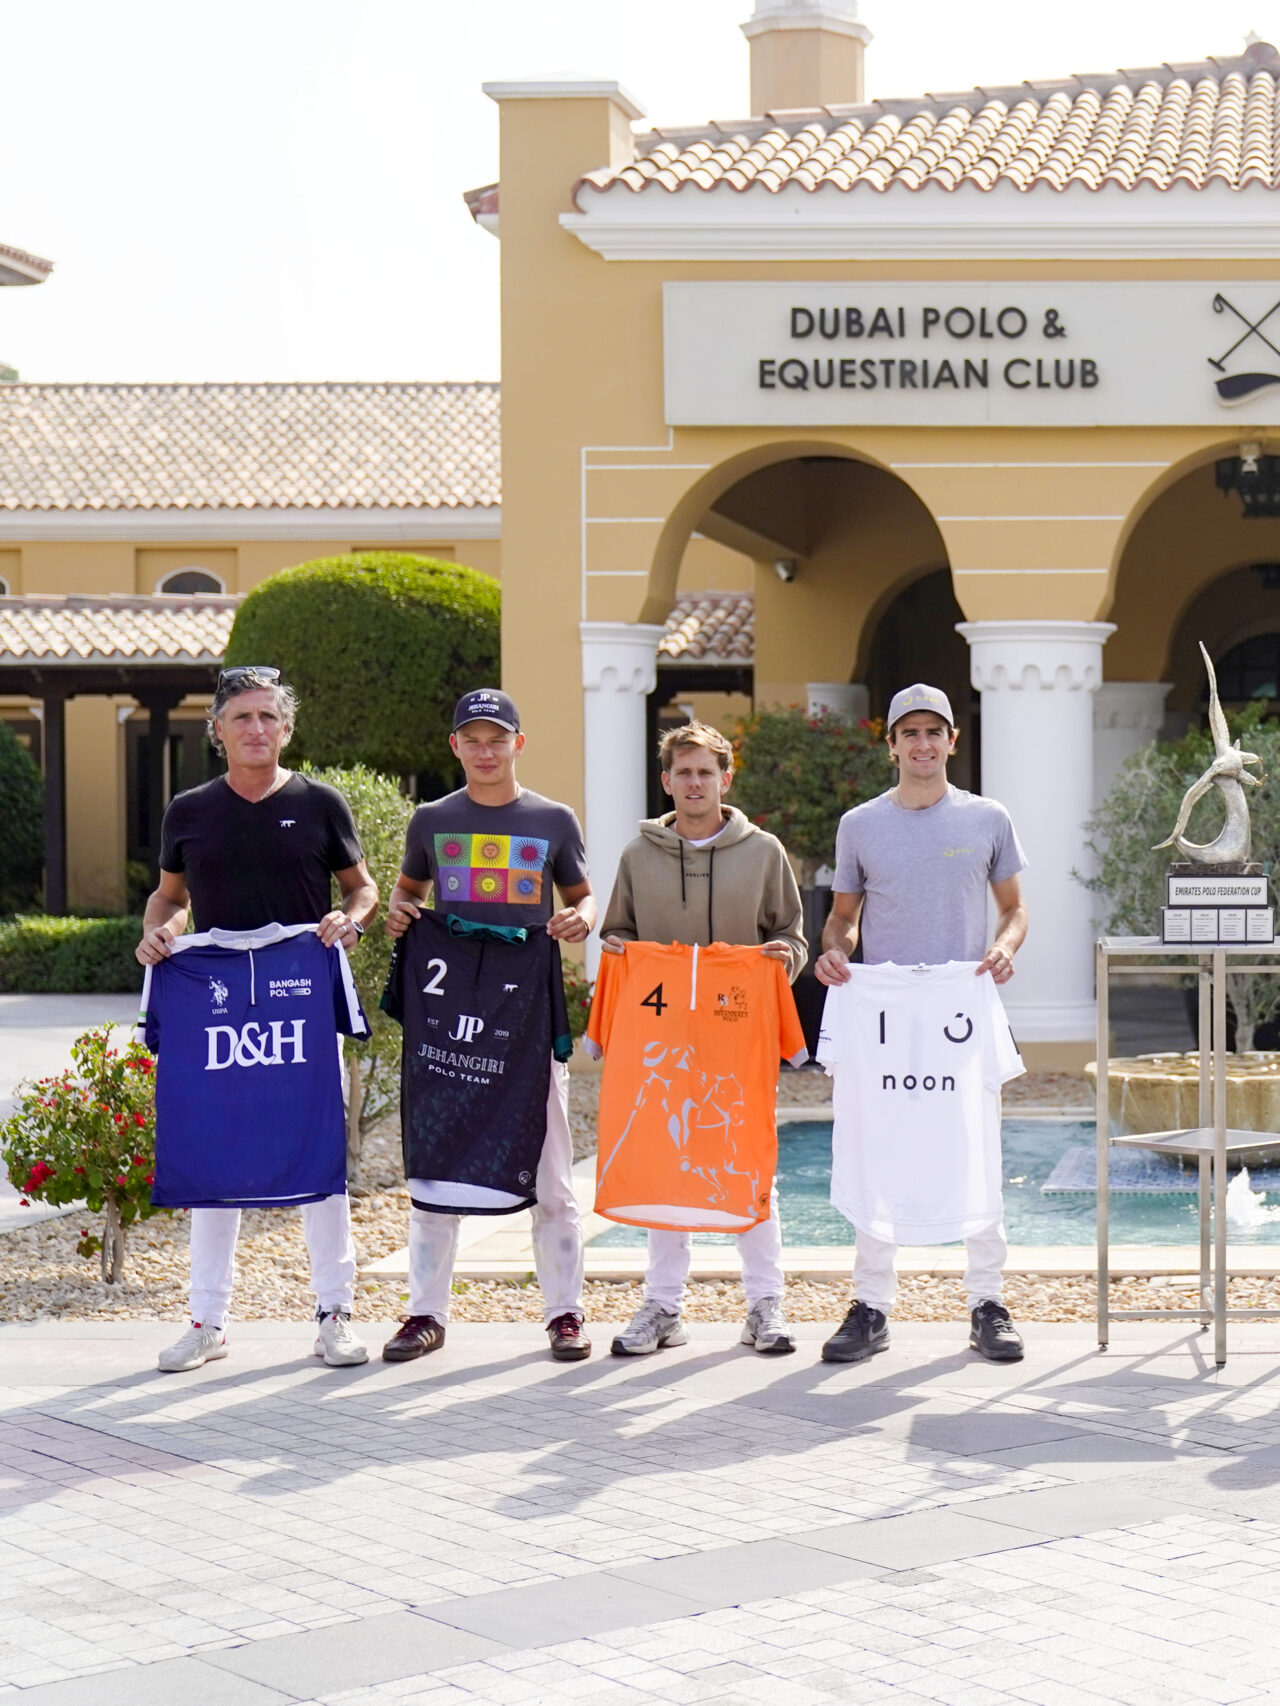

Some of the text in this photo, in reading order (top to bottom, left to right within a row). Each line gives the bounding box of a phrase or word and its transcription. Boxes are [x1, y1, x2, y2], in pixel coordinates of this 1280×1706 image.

[790, 306, 1067, 340] DUBAI POLO &
[758, 357, 1100, 391] EQUESTRIAN CLUB
[477, 693, 490, 702] JP
[1175, 886, 1262, 896] EMIRATES POLO FEDERATION CUP
[269, 978, 312, 988] BANGASH
[422, 958, 448, 996] 2
[640, 982, 668, 1016] 4
[427, 1017, 440, 1026] EST
[448, 1014, 484, 1043] JP
[494, 1029, 510, 1038] 2019
[204, 1019, 307, 1070] D&H
[417, 1043, 505, 1074] JEHANGIRI
[428, 1064, 490, 1085] POLO TEAM
[882, 1074, 955, 1091] noon
